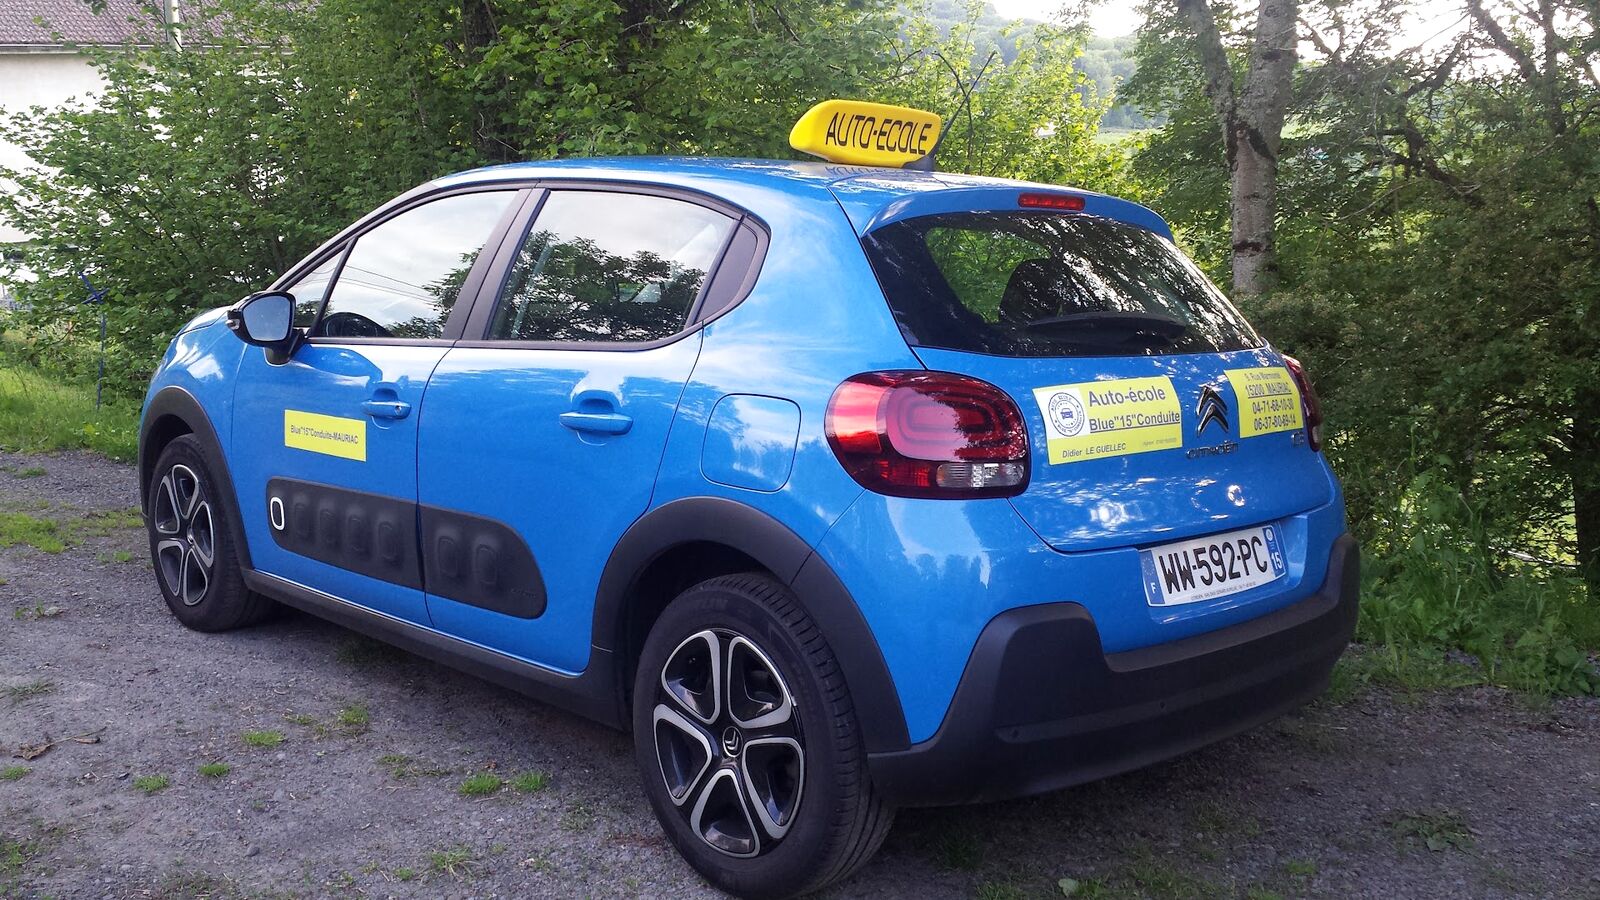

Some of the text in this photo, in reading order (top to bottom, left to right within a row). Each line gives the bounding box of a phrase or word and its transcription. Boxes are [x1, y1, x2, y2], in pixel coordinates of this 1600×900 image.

[825, 112, 932, 155] AUTO-ECOLE
[1088, 385, 1166, 407] Auto-école
[1245, 381, 1291, 396] 15200 MAURIAC
[1088, 411, 1180, 432] Blue"15"Conduite
[1062, 442, 1126, 458] Didier LE GUELLEC
[1158, 536, 1267, 594] WW-592-PC
[1270, 552, 1283, 570] 15
[1150, 582, 1157, 594] F
